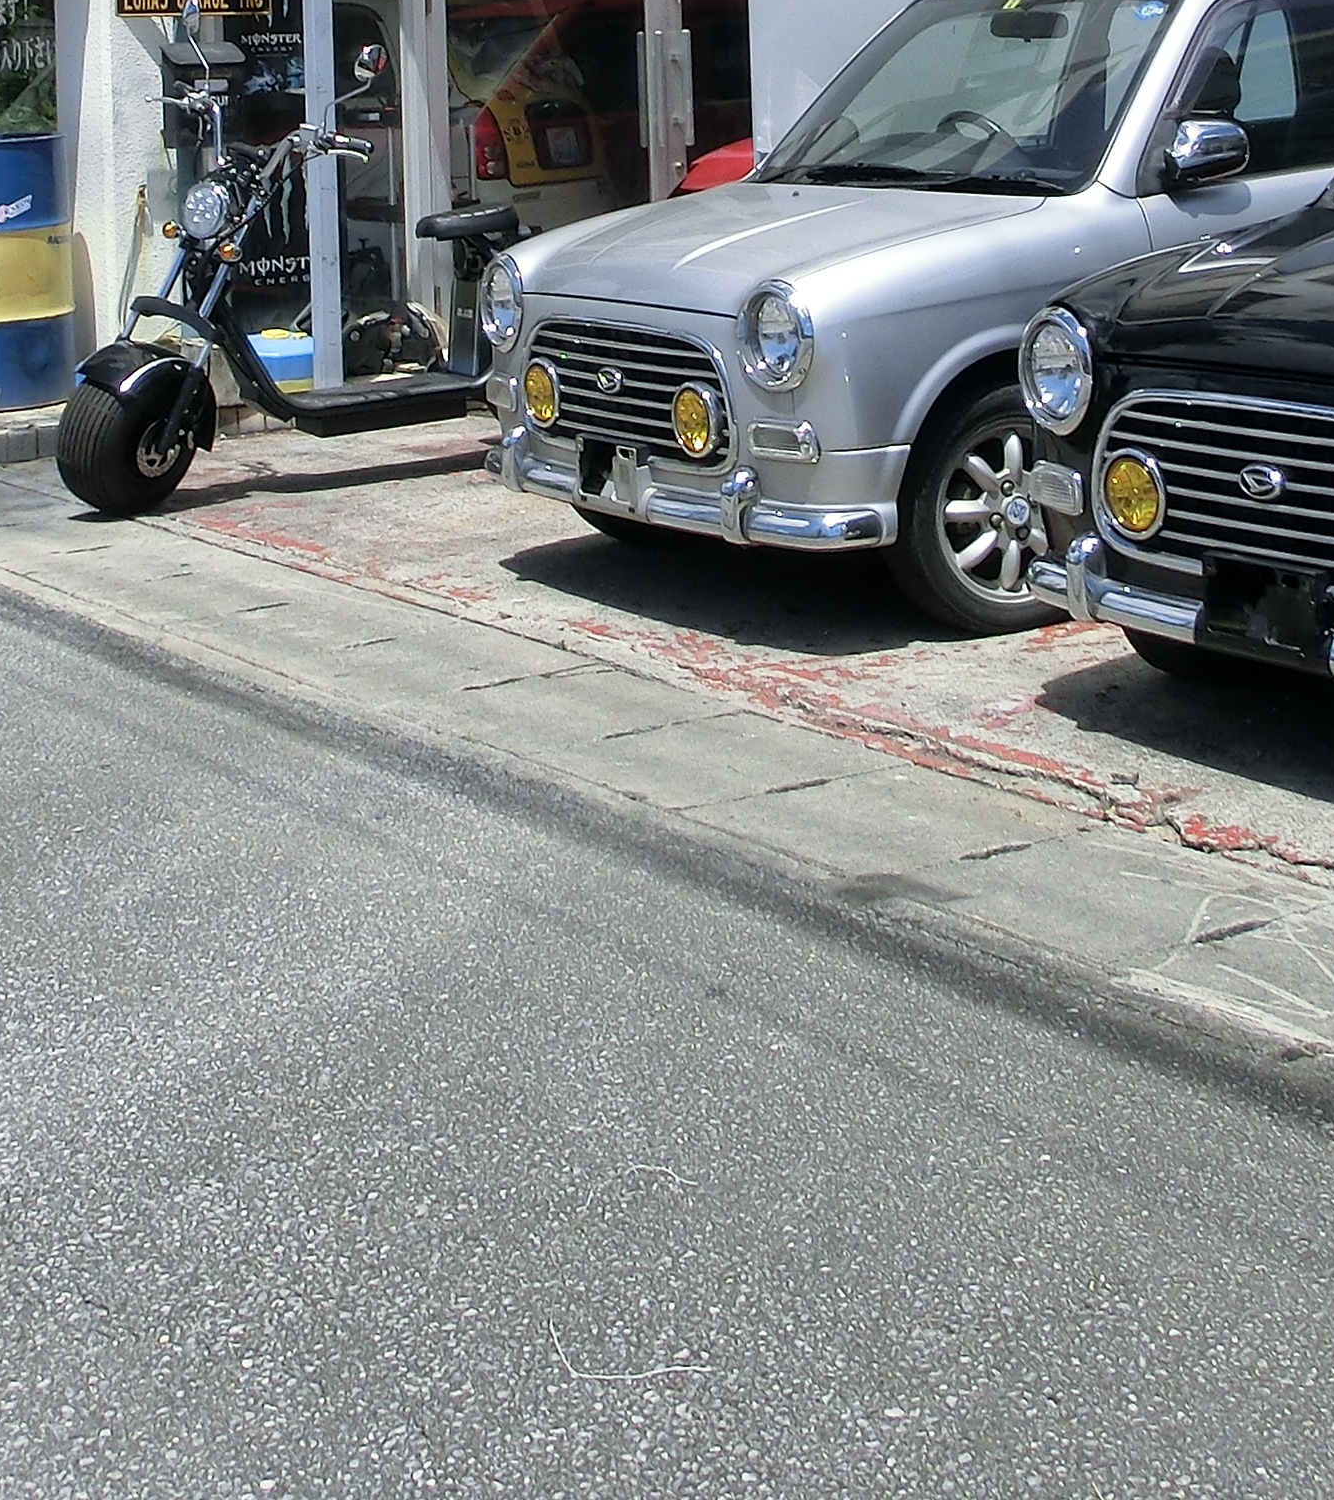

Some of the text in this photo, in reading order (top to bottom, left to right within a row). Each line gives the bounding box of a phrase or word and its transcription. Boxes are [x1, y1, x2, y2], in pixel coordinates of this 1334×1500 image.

[241, 33, 302, 46] MONSTER
[238, 255, 310, 277] MONST
[254, 274, 311, 286] ENERG
